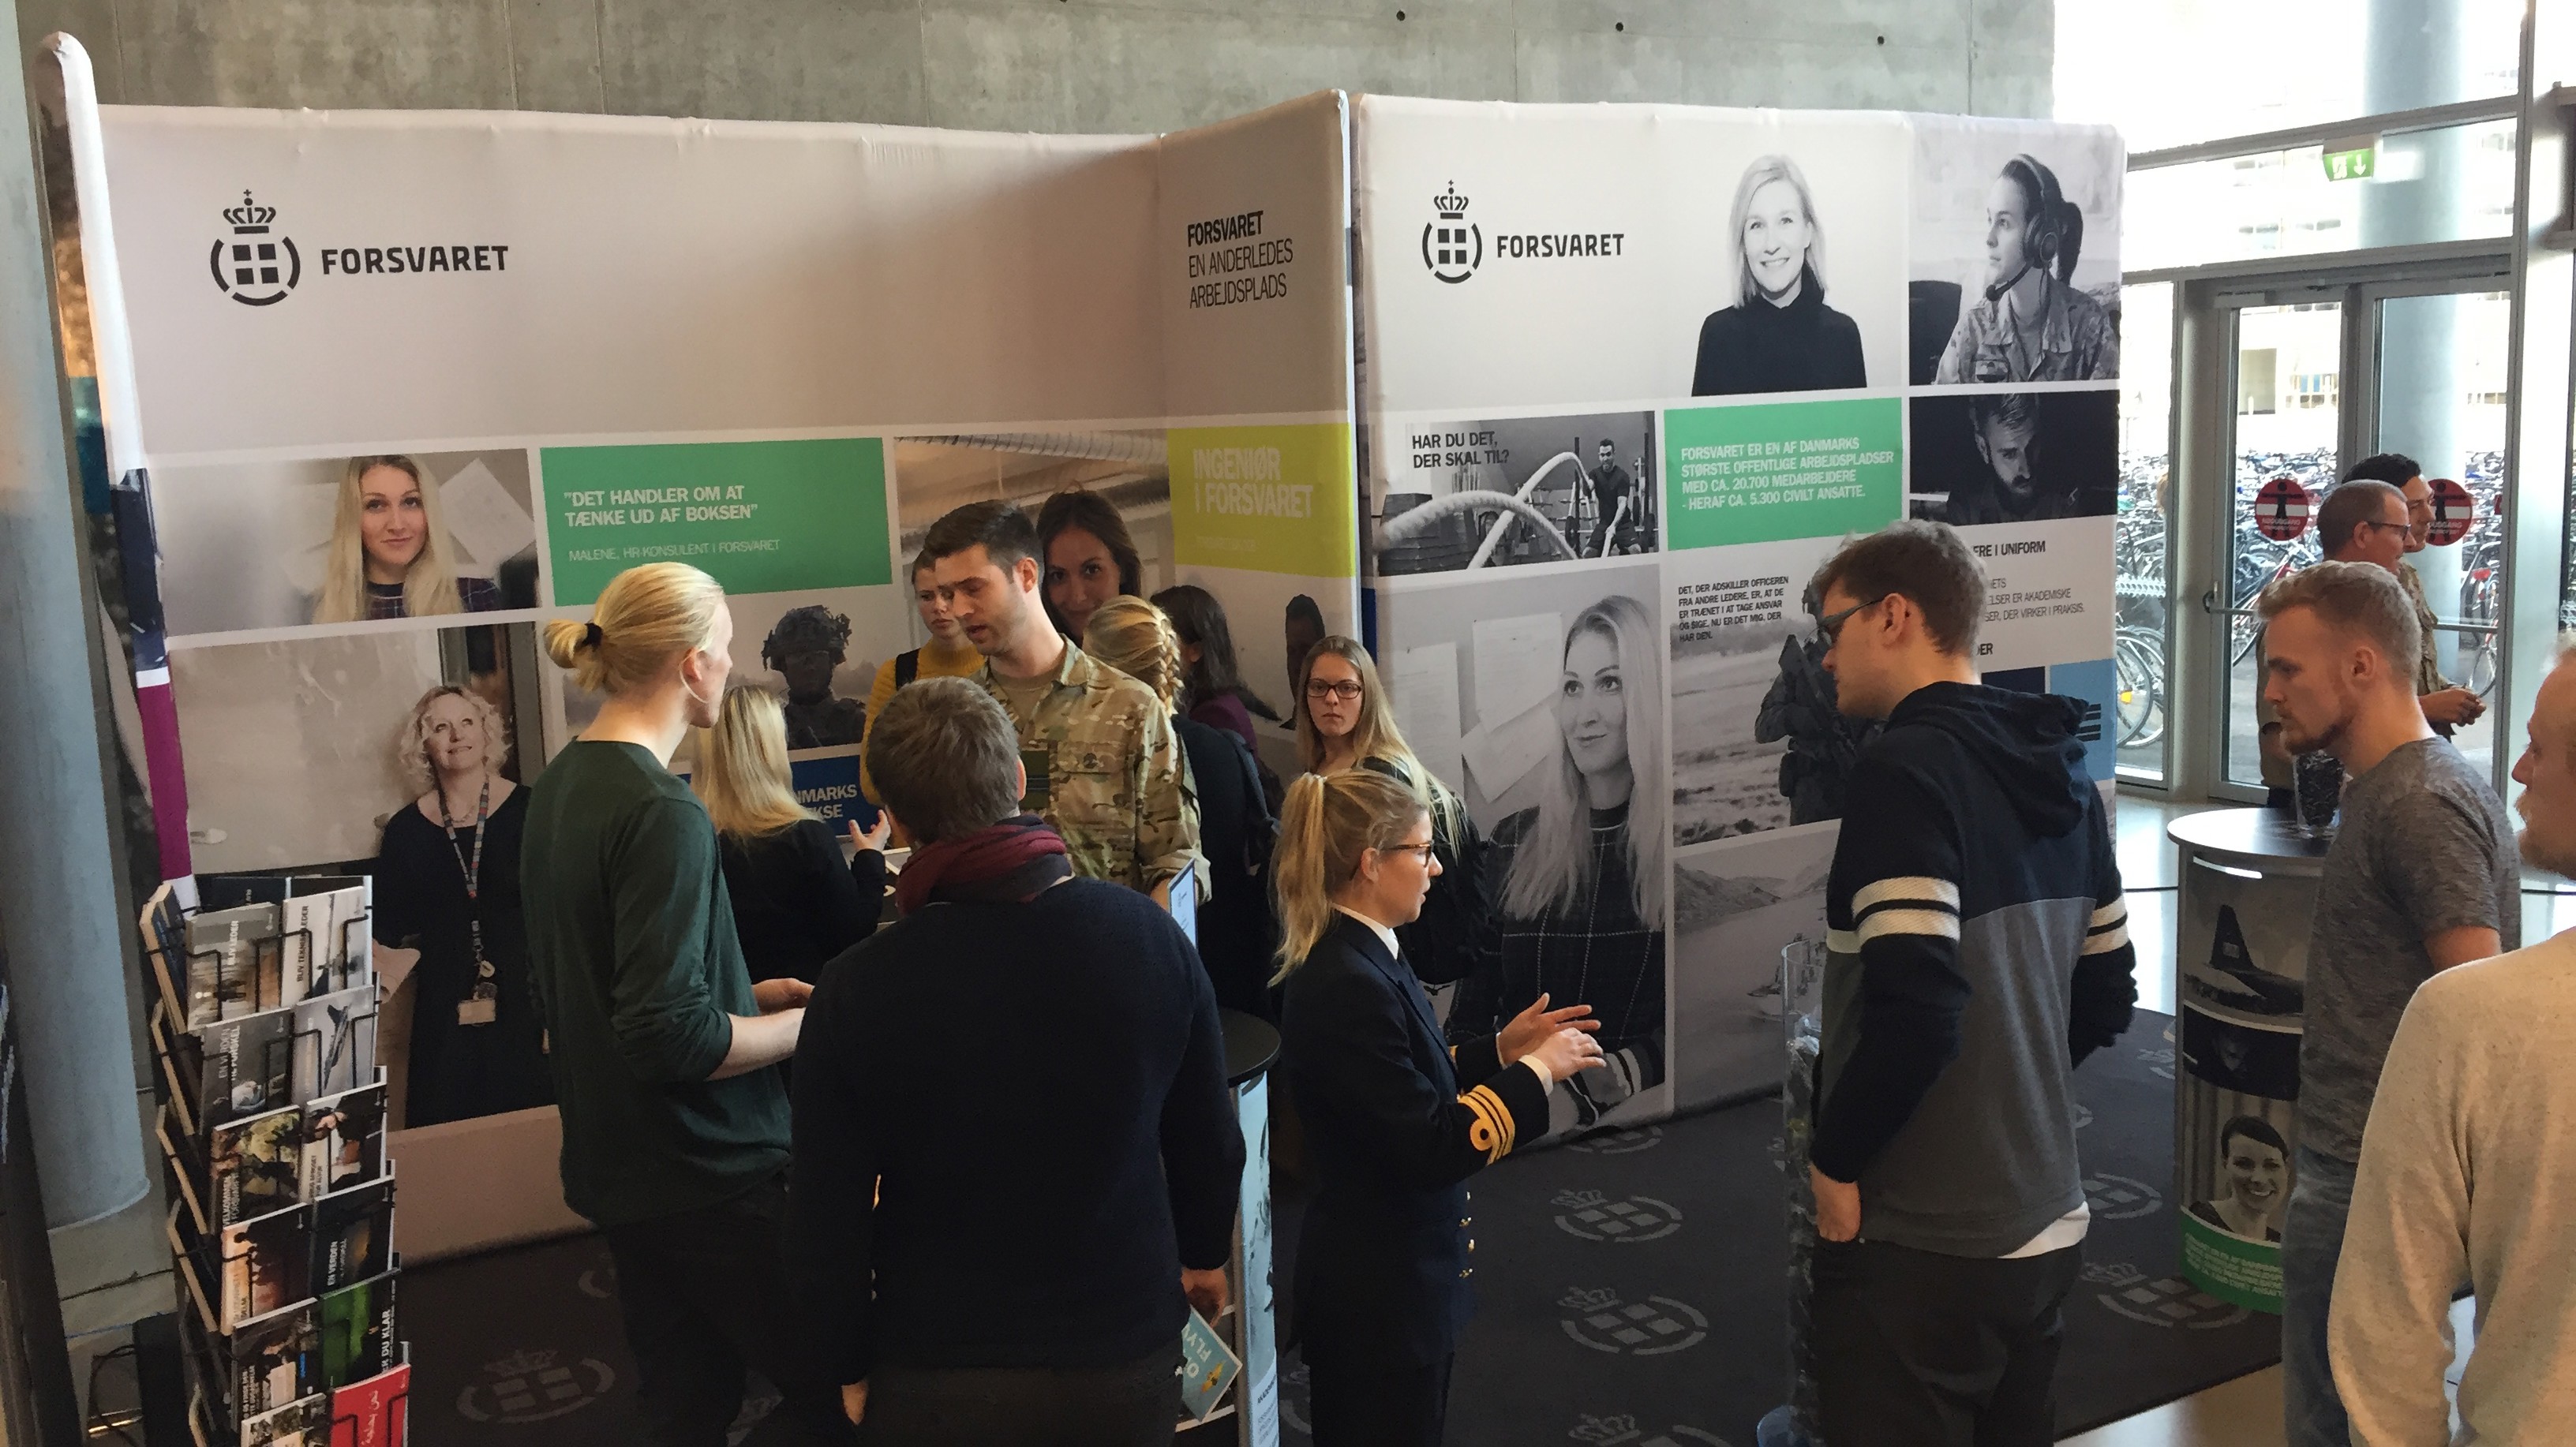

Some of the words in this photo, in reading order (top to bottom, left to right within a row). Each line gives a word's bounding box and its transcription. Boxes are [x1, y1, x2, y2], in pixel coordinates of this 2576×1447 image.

[1188, 210, 1264, 247] FORSVARET
[1497, 234, 1624, 258] FORSVARET
[321, 245, 508, 275] FORSVARET
[1189, 253, 1205, 278] EN
[1209, 238, 1294, 275] ANDERLEDES
[1189, 272, 1286, 308] ARBEJDSPLADS
[1412, 434, 1440, 450] HAR
[1445, 432, 1465, 447] DU
[1469, 431, 1498, 447] DET,
[1681, 443, 1744, 461] FORSVARET
[1747, 443, 1762, 456] ER
[1765, 442, 1780, 454] EN
[1783, 440, 1798, 454] AF
[1800, 437, 1859, 452] DANMARKS
[1193, 447, 1281, 480] INGENIØR
[1413, 453, 1441, 469] DER
[1445, 451, 1481, 466] SKAL
[1485, 449, 1510, 464] TIL?
[1681, 462, 1730, 478] STØRSTE
[1733, 458, 1797, 473] OFFENTLIGE
[1799, 451, 1894, 469] ARBEJDSPLADSER
[1683, 480, 1708, 494] MED
[1711, 478, 1729, 492] CA.
[1732, 476, 1769, 491] 20.700
[1772, 469, 1856, 488] MEDARBEJDERE
[610, 487, 689, 505] HANDLER
[693, 485, 721, 502] OM
[725, 484, 745, 500] AT
[1195, 482, 1200, 513] I
[1205, 482, 1313, 518] FORSVARET
[1688, 495, 1725, 510] HERAF
[1728, 493, 1747, 507] CA.
[1750, 491, 1780, 505] 5.300
[1783, 488, 1814, 503] CIVILT
[1817, 485, 1866, 500] ANSATTE.
[565, 510, 625, 527] TÆNKE
[631, 509, 654, 524] UD
[660, 507, 681, 523] AF
[568, 548, 620, 562] MALENE,
[623, 547, 640, 559] HR
[642, 542, 709, 559] KONSULENT
[719, 539, 781, 553] FORSVARET
[1995, 544, 1998, 556] I
[2001, 540, 2046, 555] UNIFORM
[1678, 585, 1693, 595] DET,
[1695, 584, 1709, 593] DER
[1712, 580, 1750, 592] ADSKILLER
[1750, 576, 1789, 587] OFFICEREN
[2012, 592, 2023, 603] ER
[2024, 588, 2071, 602] AKADEMISKE
[1679, 598, 1693, 607] FRA
[1694, 595, 1719, 605] ANDRE
[1774, 588, 1784, 596] DE
[1690, 606, 1720, 617] TRÆNET
[1725, 604, 1735, 613] AT
[1736, 602, 1754, 612] TAGE
[1755, 600, 1782, 610] ANSVAR
[2003, 608, 2019, 620] DER
[2021, 605, 2047, 619] VIRKER
[2053, 603, 2084, 615] PRAKSIS.
[1679, 622, 1690, 630] OG
[1711, 618, 1722, 627] NU
[1724, 617, 1733, 626] ER
[1735, 615, 1748, 624] DET
[1767, 611, 1782, 620] DER
[1679, 632, 1694, 642] HAR
[810, 804, 843, 818] KSE
[229, 920, 239, 946] LEDER
[296, 965, 305, 982] BLIV
[381, 1309, 391, 1339] KLAR
[381, 1341, 390, 1357] DU
